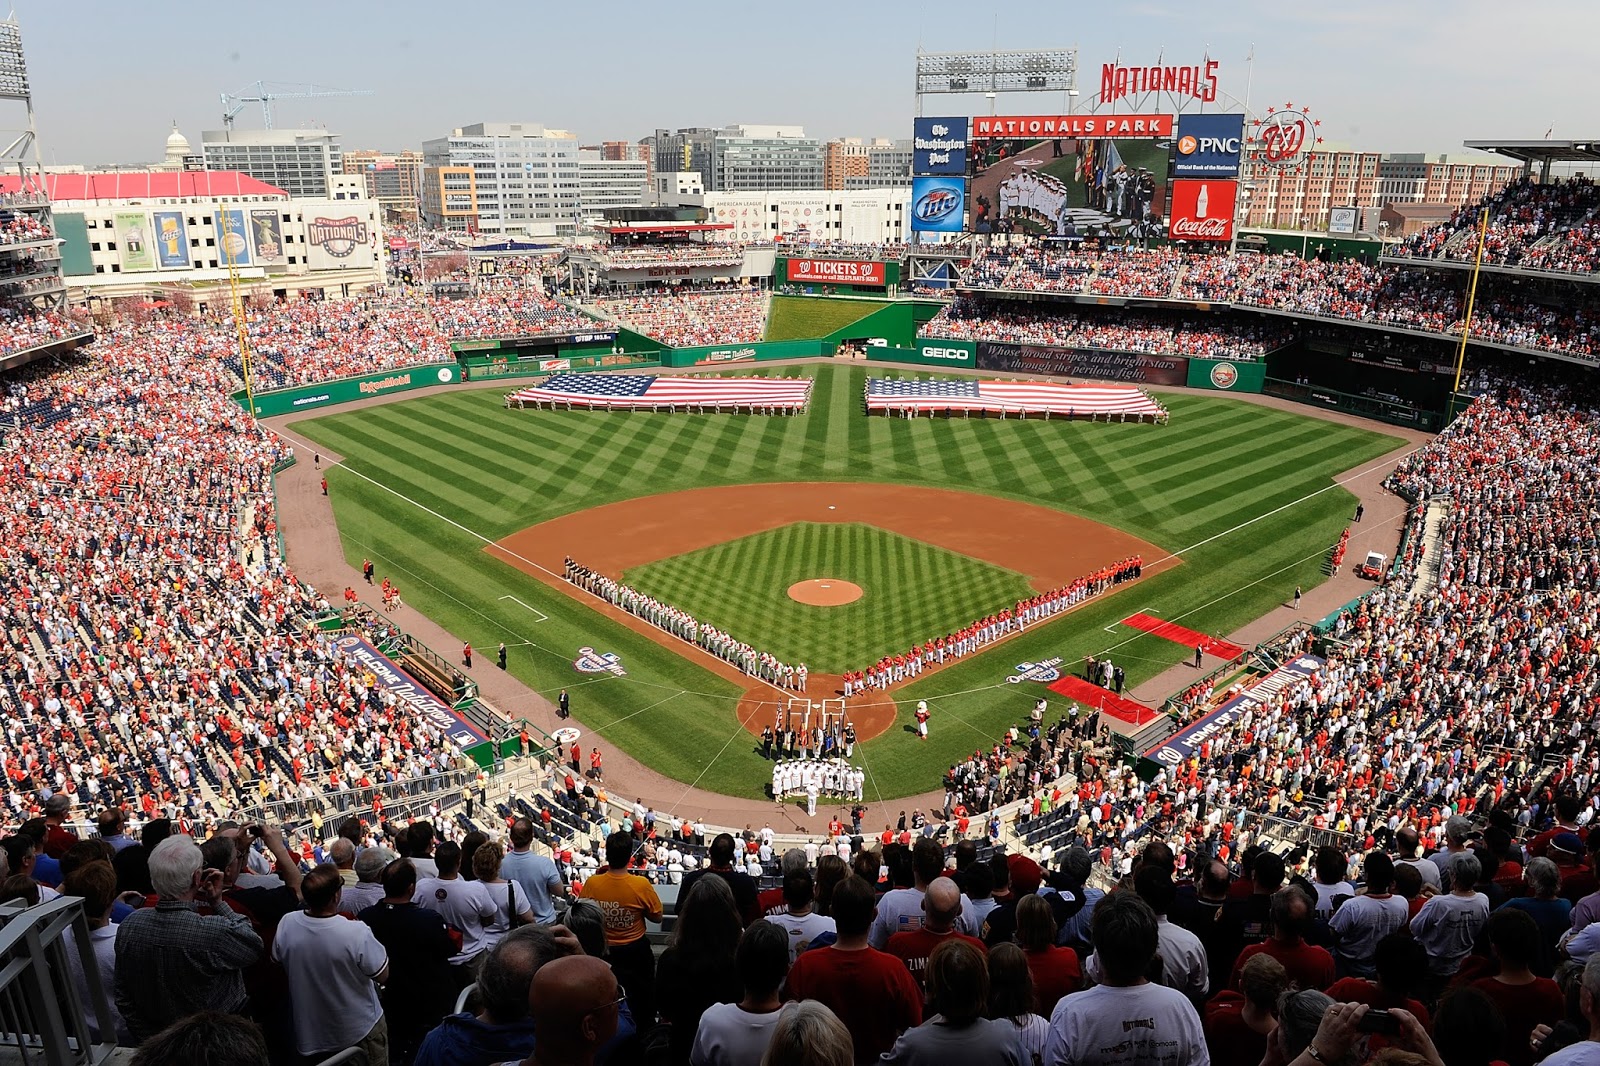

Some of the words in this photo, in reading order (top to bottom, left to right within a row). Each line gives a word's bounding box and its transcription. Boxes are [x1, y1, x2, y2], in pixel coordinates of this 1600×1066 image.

[1100, 61, 1218, 103] NATIONALS
[932, 124, 949, 136] The
[979, 119, 1095, 133] NATIONALS
[1105, 119, 1161, 132] PARK
[915, 137, 965, 151] Washington
[1199, 137, 1240, 153] PNC
[929, 152, 949, 166] Post
[921, 196, 956, 218] Lite
[317, 217, 358, 226] WASHINGTON
[1172, 217, 1230, 237] Coca-Cola
[310, 223, 366, 244] NATIONALS
[813, 261, 857, 275] TICKETS
[922, 347, 969, 360] GEICO
[988, 345, 1020, 357] Whose
[1022, 347, 1052, 359] broad
[1055, 351, 1088, 364] stripes
[1090, 352, 1112, 365] and
[1113, 354, 1147, 369] bright
[1149, 357, 1177, 370] stars
[1011, 359, 1052, 373] through
[1054, 361, 1071, 372] the
[1071, 363, 1116, 377] perilous
[1117, 366, 1147, 380] fight,
[359, 374, 411, 393] ExxonMobil
[293, 395, 330, 406] nationals.com
[352, 647, 402, 685] WELCOME
[1240, 665, 1311, 703] NATIONALS
[388, 682, 456, 729] NatsTown
[1229, 698, 1257, 715] THE
[1218, 713, 1233, 727] OF
[1181, 722, 1220, 748] HOME
[604, 908, 625, 917] NOT
[766, 903, 789, 916] ZIMM
[604, 914, 636, 923] CTATOR
[1122, 1017, 1155, 1032] NATIONALS
